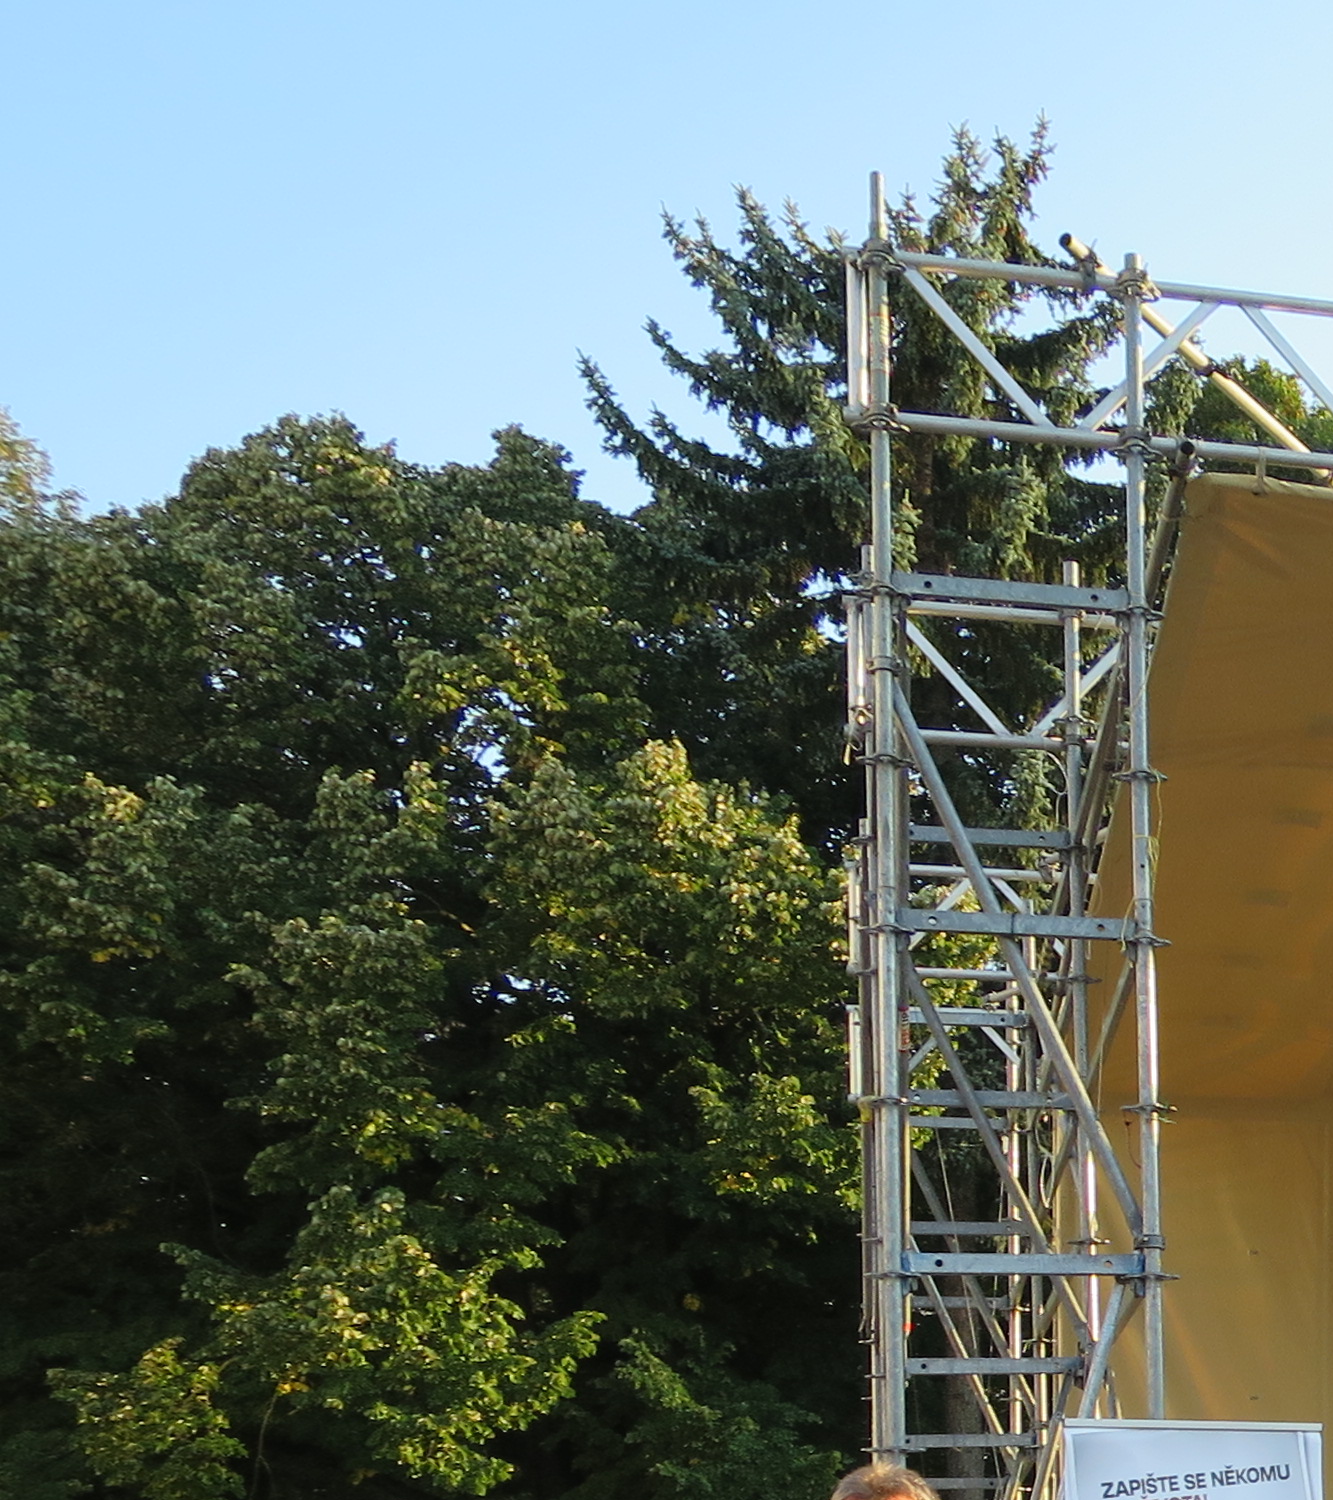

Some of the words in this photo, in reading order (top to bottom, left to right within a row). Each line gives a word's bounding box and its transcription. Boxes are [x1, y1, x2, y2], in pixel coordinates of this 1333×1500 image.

[1101, 1472, 1180, 1500] ZAPIŠTE
[1184, 1472, 1207, 1491] SE
[1211, 1464, 1291, 1487] NĚKOMU
